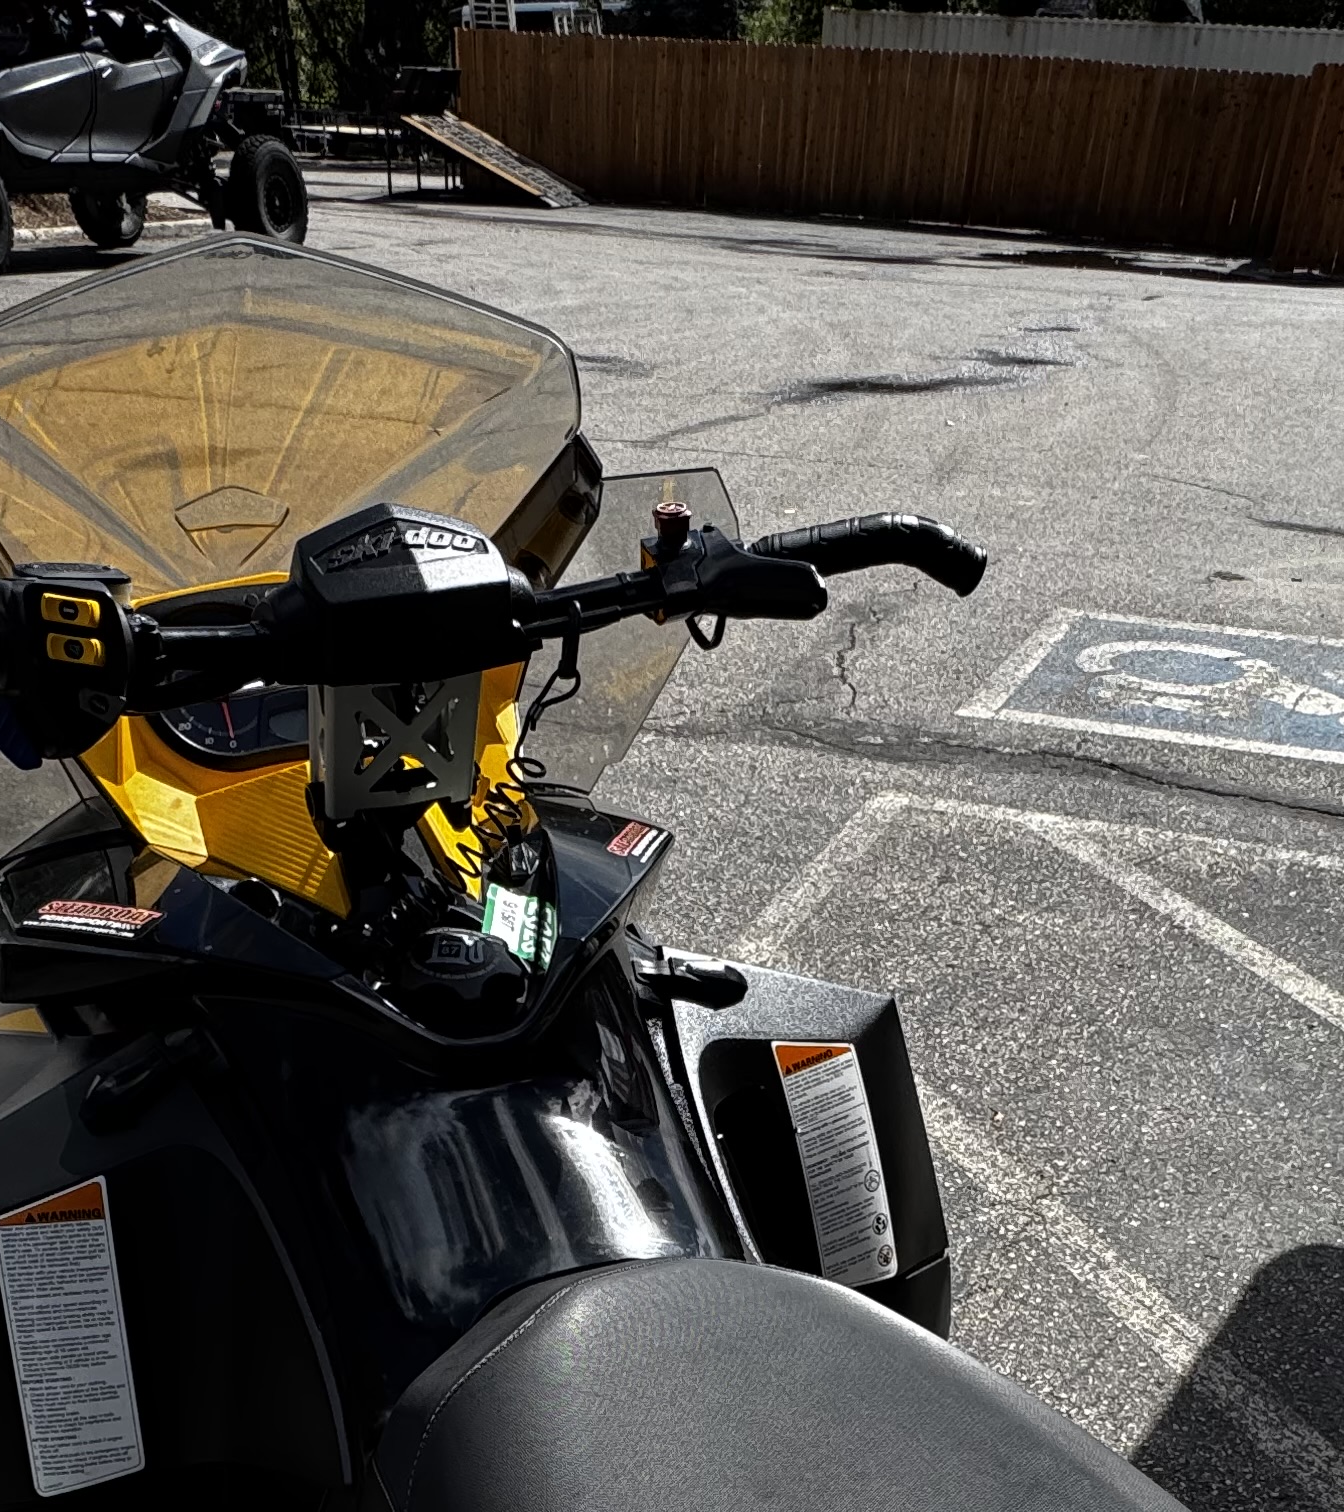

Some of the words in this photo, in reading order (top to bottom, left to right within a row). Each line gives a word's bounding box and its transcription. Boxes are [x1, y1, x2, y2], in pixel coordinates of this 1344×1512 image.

[178, 722, 192, 731] 20
[205, 737, 214, 745] 10
[229, 740, 237, 748] 0
[791, 1049, 834, 1072] WARNING
[37, 1208, 101, 1222] WARNING
